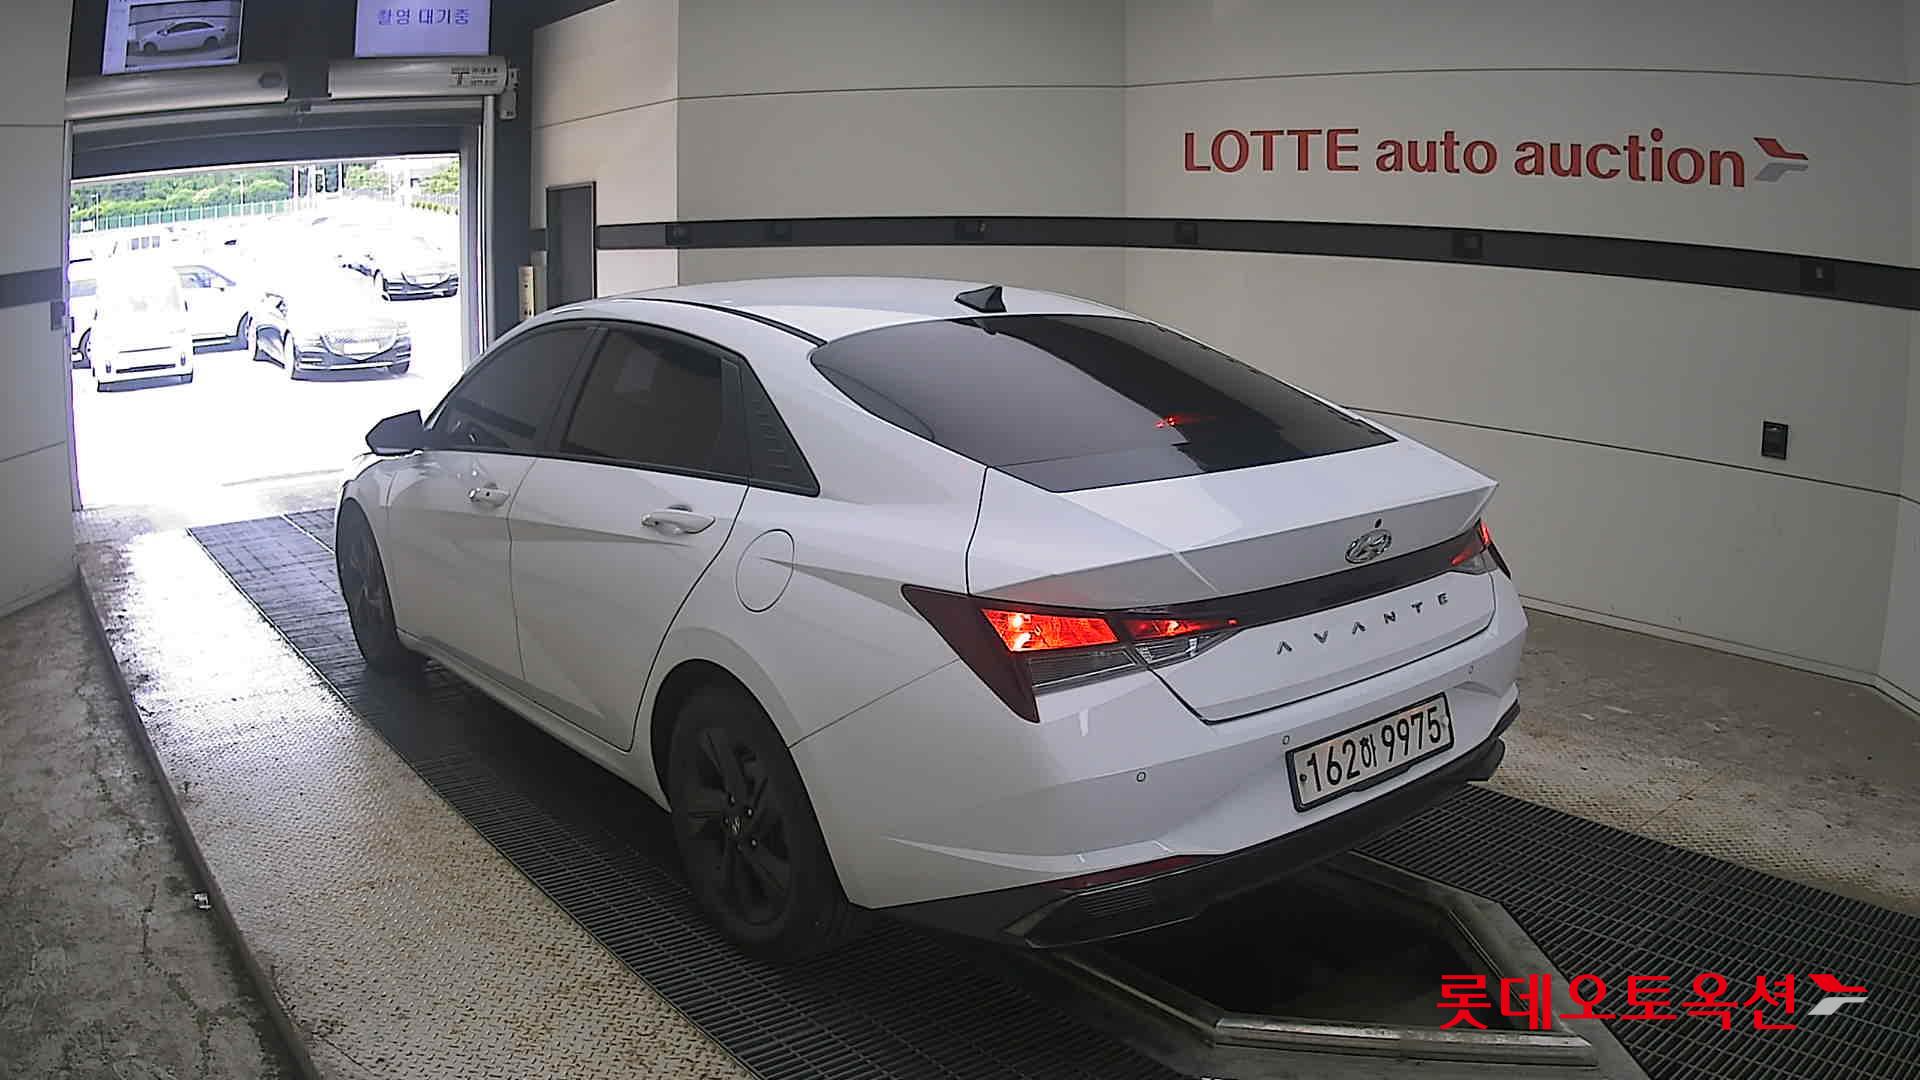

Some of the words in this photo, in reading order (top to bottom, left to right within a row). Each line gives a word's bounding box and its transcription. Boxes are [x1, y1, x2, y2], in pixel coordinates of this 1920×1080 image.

[418, 7, 470, 25] 대기중
[1183, 128, 1359, 172] LOTTE
[1375, 130, 1498, 174] auto
[1514, 127, 1745, 188] auction
[1276, 592, 1450, 656] AVANTE
